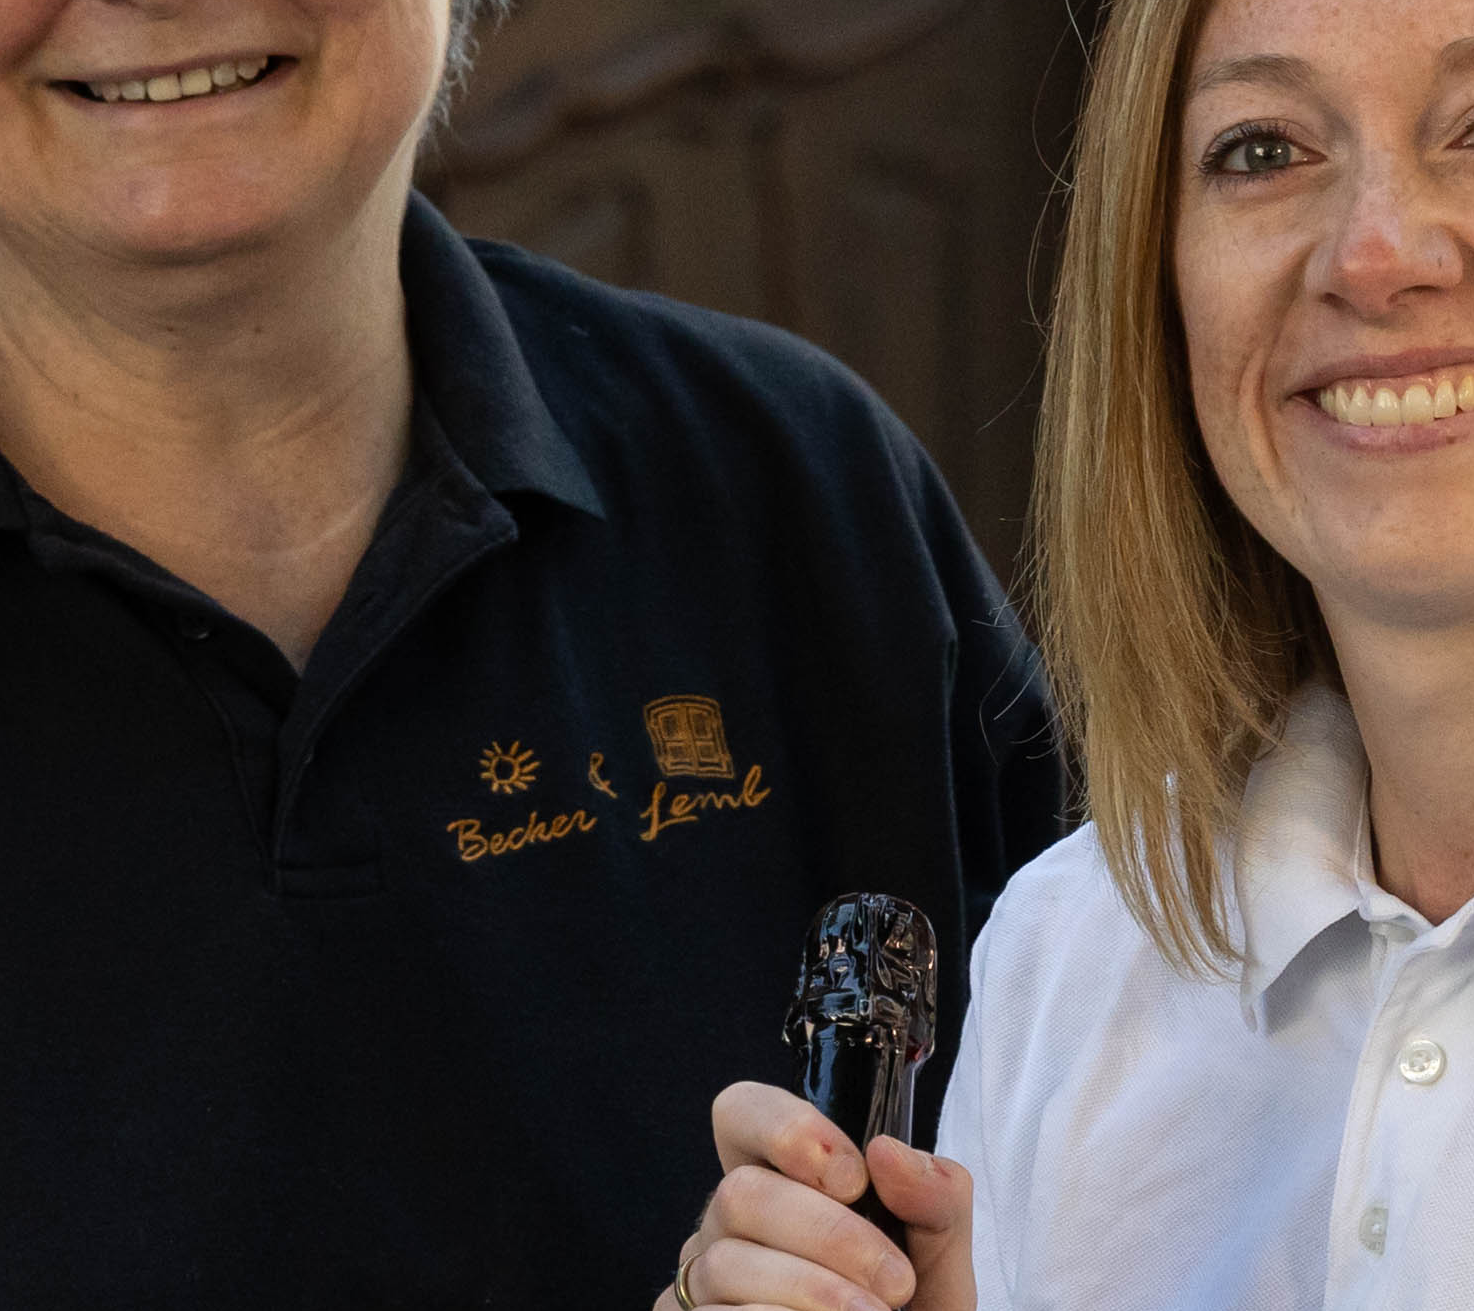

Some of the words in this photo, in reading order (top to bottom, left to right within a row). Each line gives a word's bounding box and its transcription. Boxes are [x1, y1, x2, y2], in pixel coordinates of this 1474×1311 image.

[446, 809, 598, 861] Becker
[588, 752, 619, 799] &
[639, 764, 771, 842] Lemb
